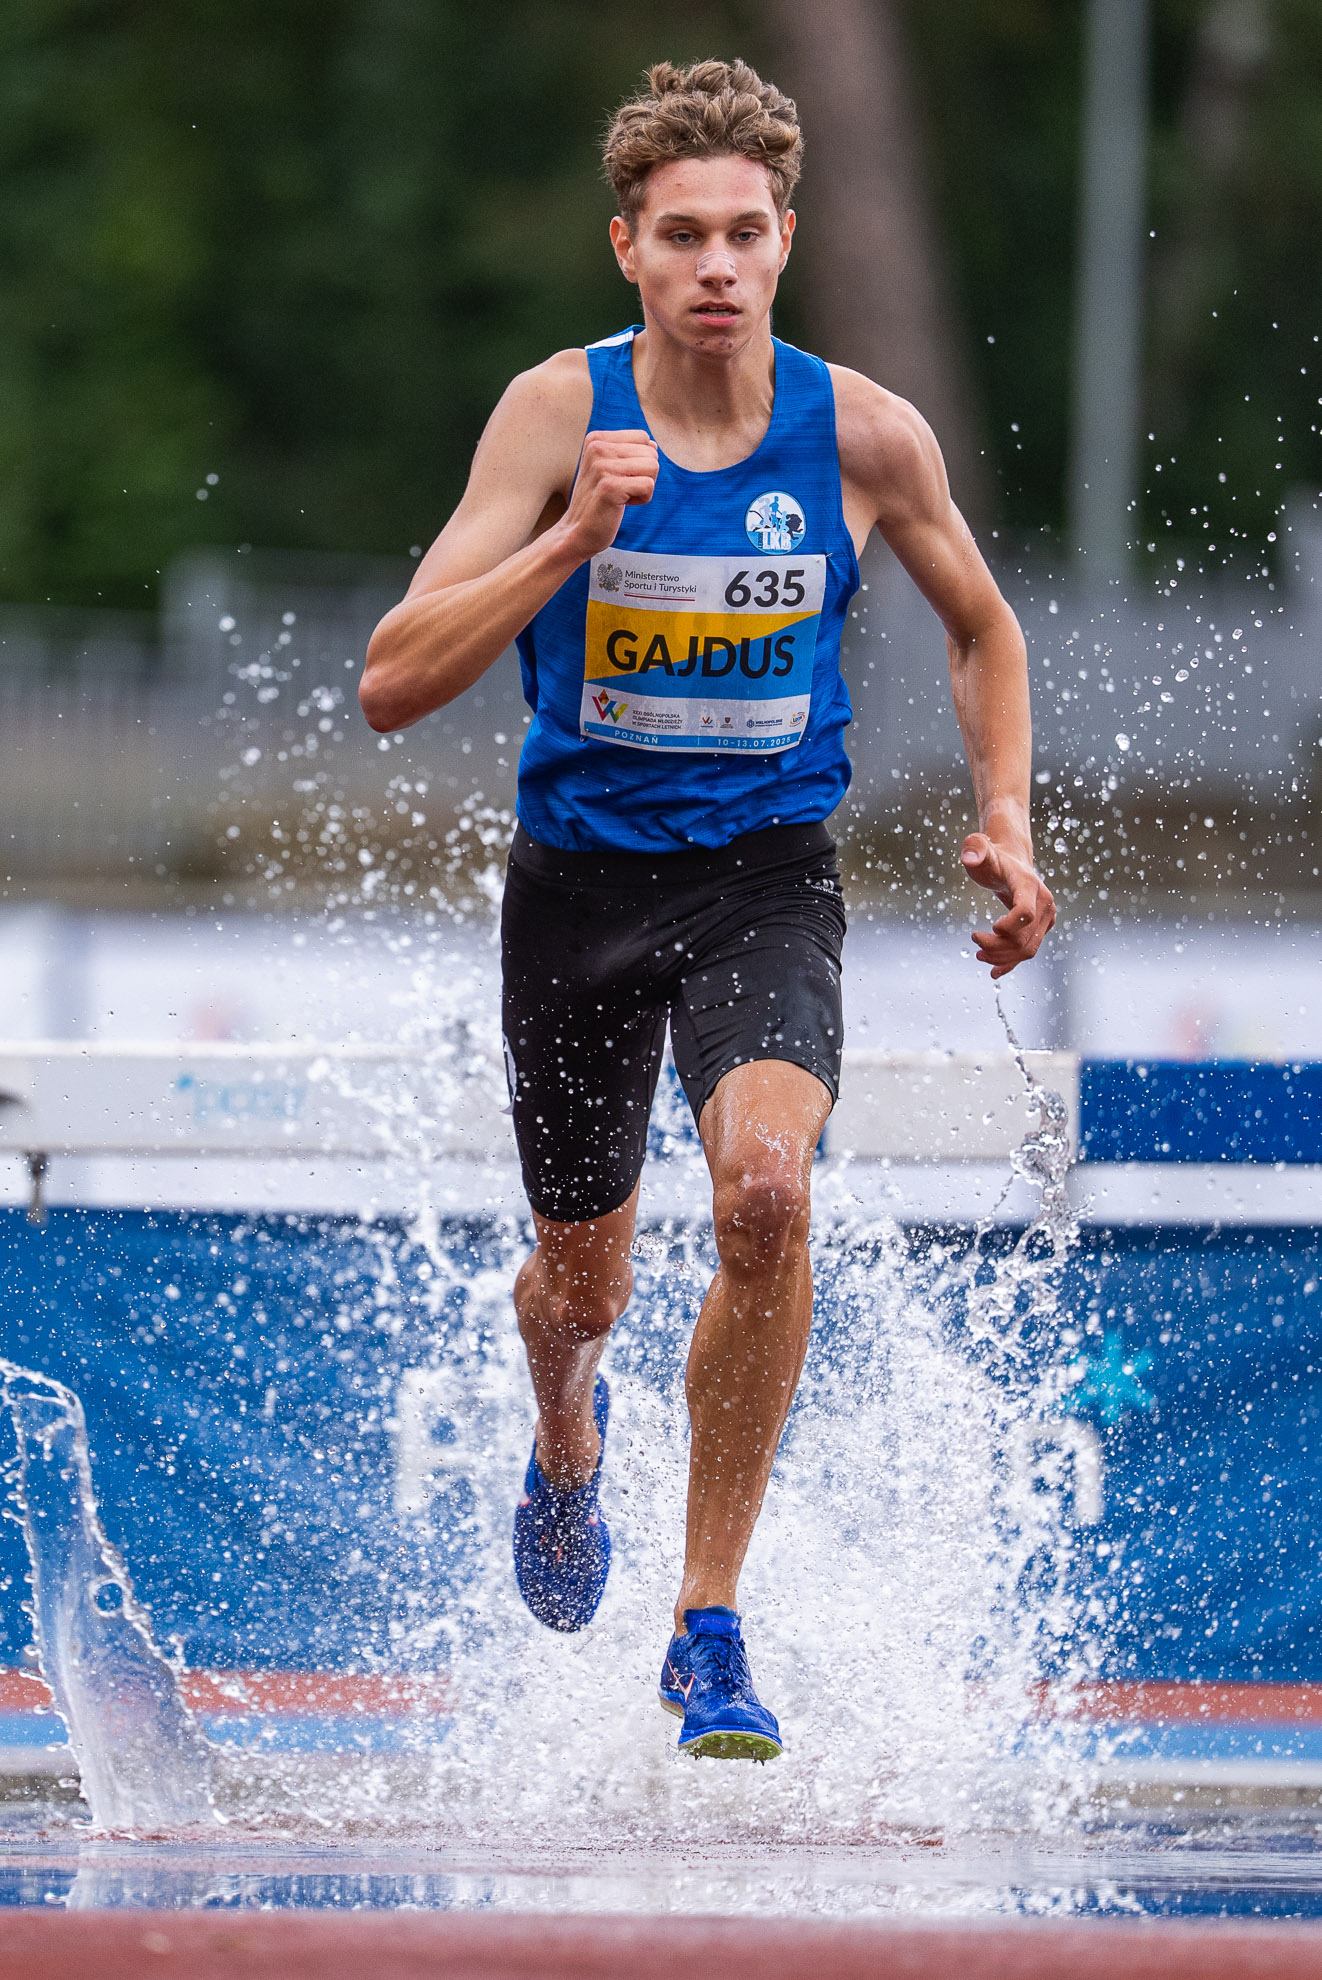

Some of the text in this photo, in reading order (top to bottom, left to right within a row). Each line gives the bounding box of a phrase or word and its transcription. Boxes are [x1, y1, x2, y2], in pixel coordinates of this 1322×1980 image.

[625, 569, 680, 583] Ministerstwo
[624, 579, 652, 593] Sportu
[659, 583, 697, 594] Turystyki
[724, 569, 805, 608] 635
[606, 629, 796, 679] GAJDUS
[614, 729, 659, 744] POZNAŃ
[717, 736, 791, 747] 10-13.07.2025
